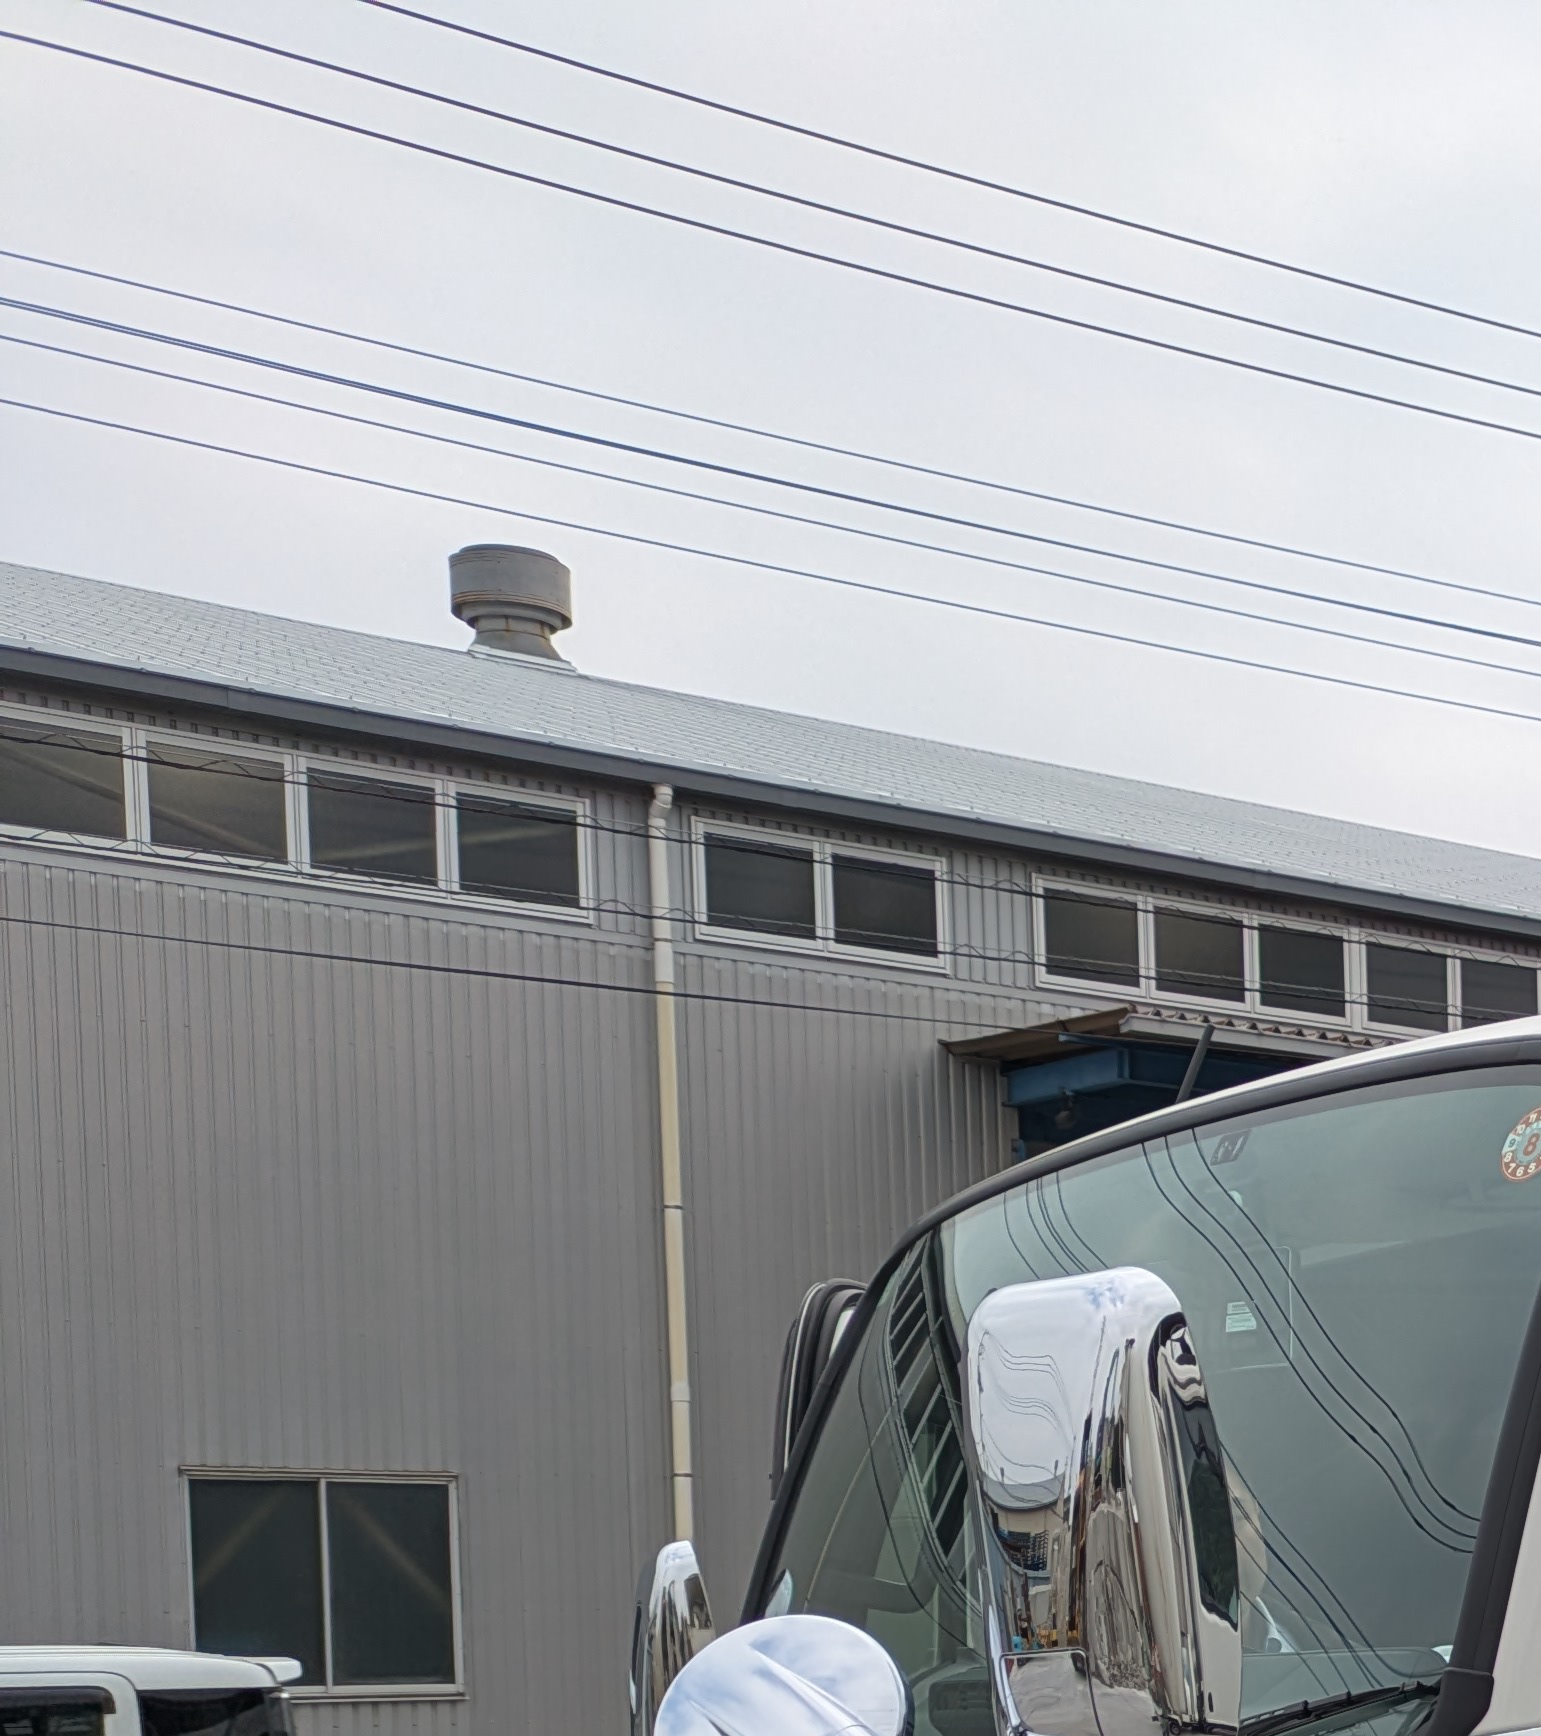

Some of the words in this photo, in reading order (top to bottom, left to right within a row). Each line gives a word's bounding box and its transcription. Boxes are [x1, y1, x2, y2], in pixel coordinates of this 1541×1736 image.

[1508, 1138, 1517, 1148] 9
[1523, 1133, 1540, 1156] 8
[1504, 1152, 1512, 1162] 8
[1508, 1163, 1516, 1173] 7
[1516, 1166, 1524, 1176] 6
[1527, 1163, 1536, 1173] 5
